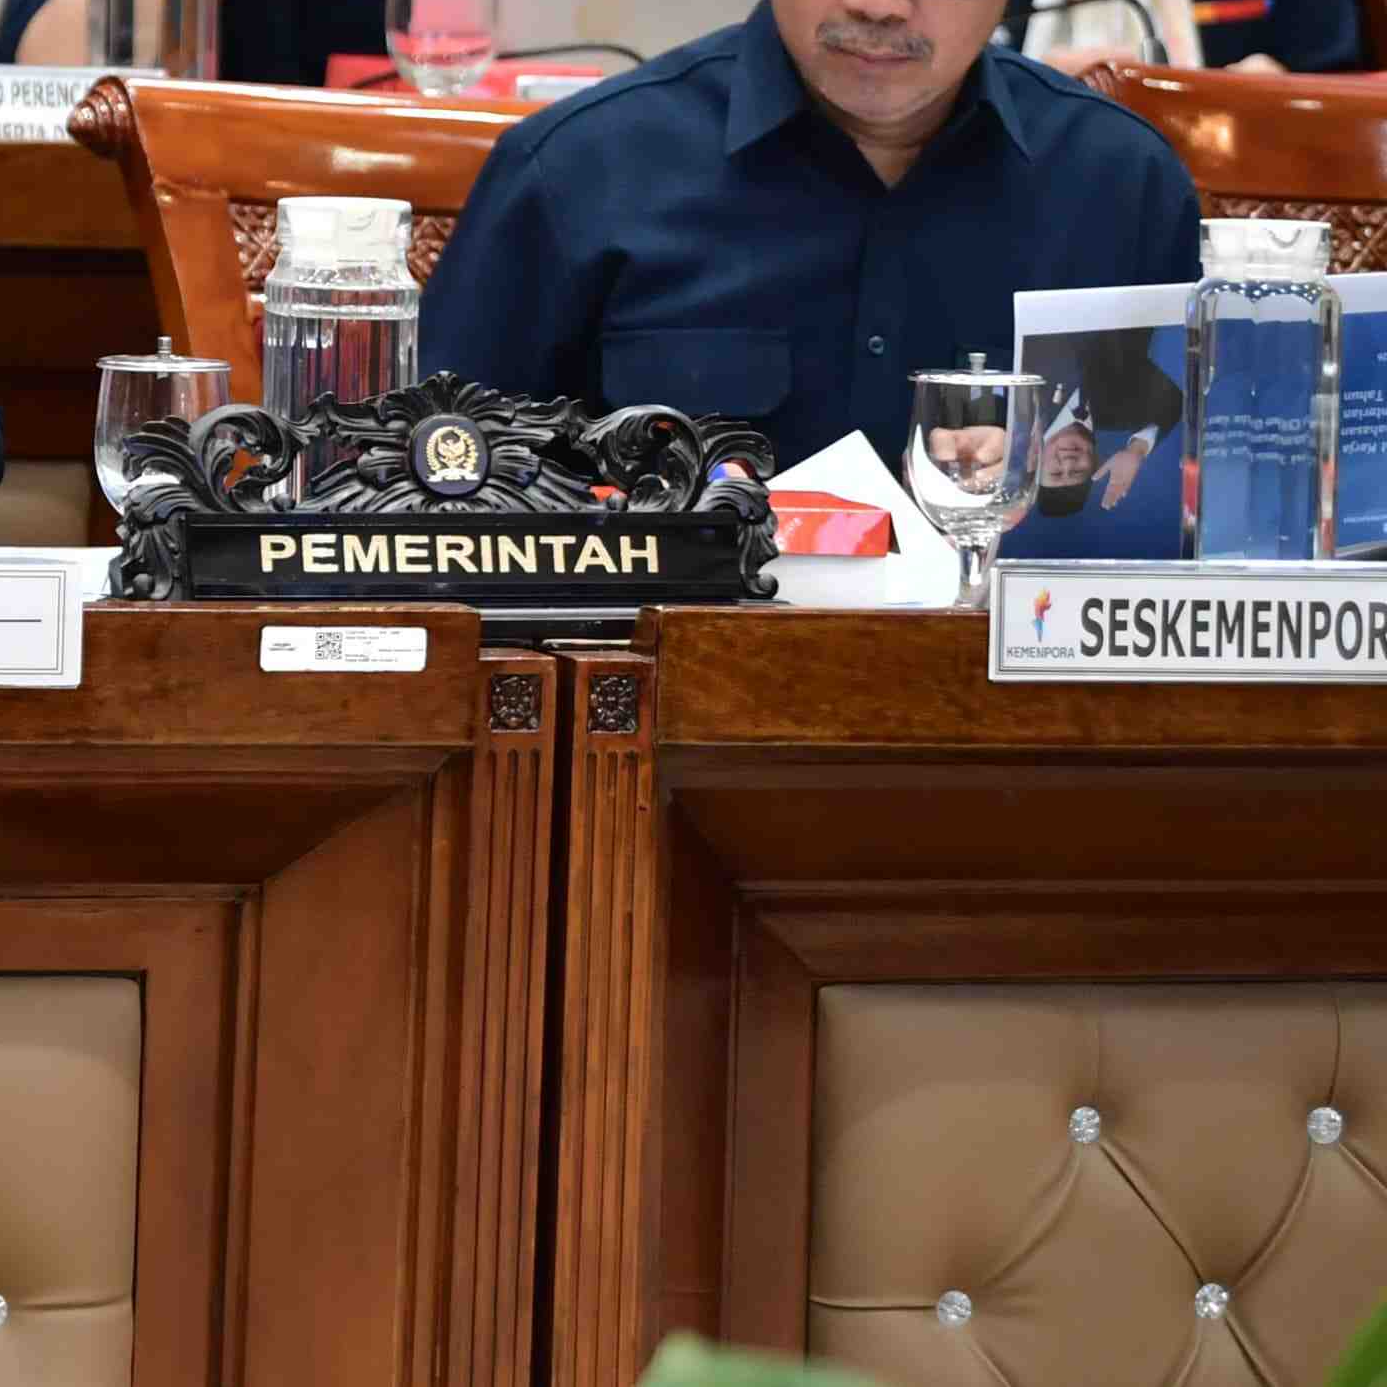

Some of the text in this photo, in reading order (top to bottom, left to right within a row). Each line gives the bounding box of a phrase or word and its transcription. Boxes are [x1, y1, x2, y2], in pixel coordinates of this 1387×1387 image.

[10, 78, 89, 107] PERENC
[259, 533, 659, 574] PEMERINTAH
[1080, 597, 1387, 661] SESKEMENPOR
[1006, 645, 1076, 659] KEMENPORA
